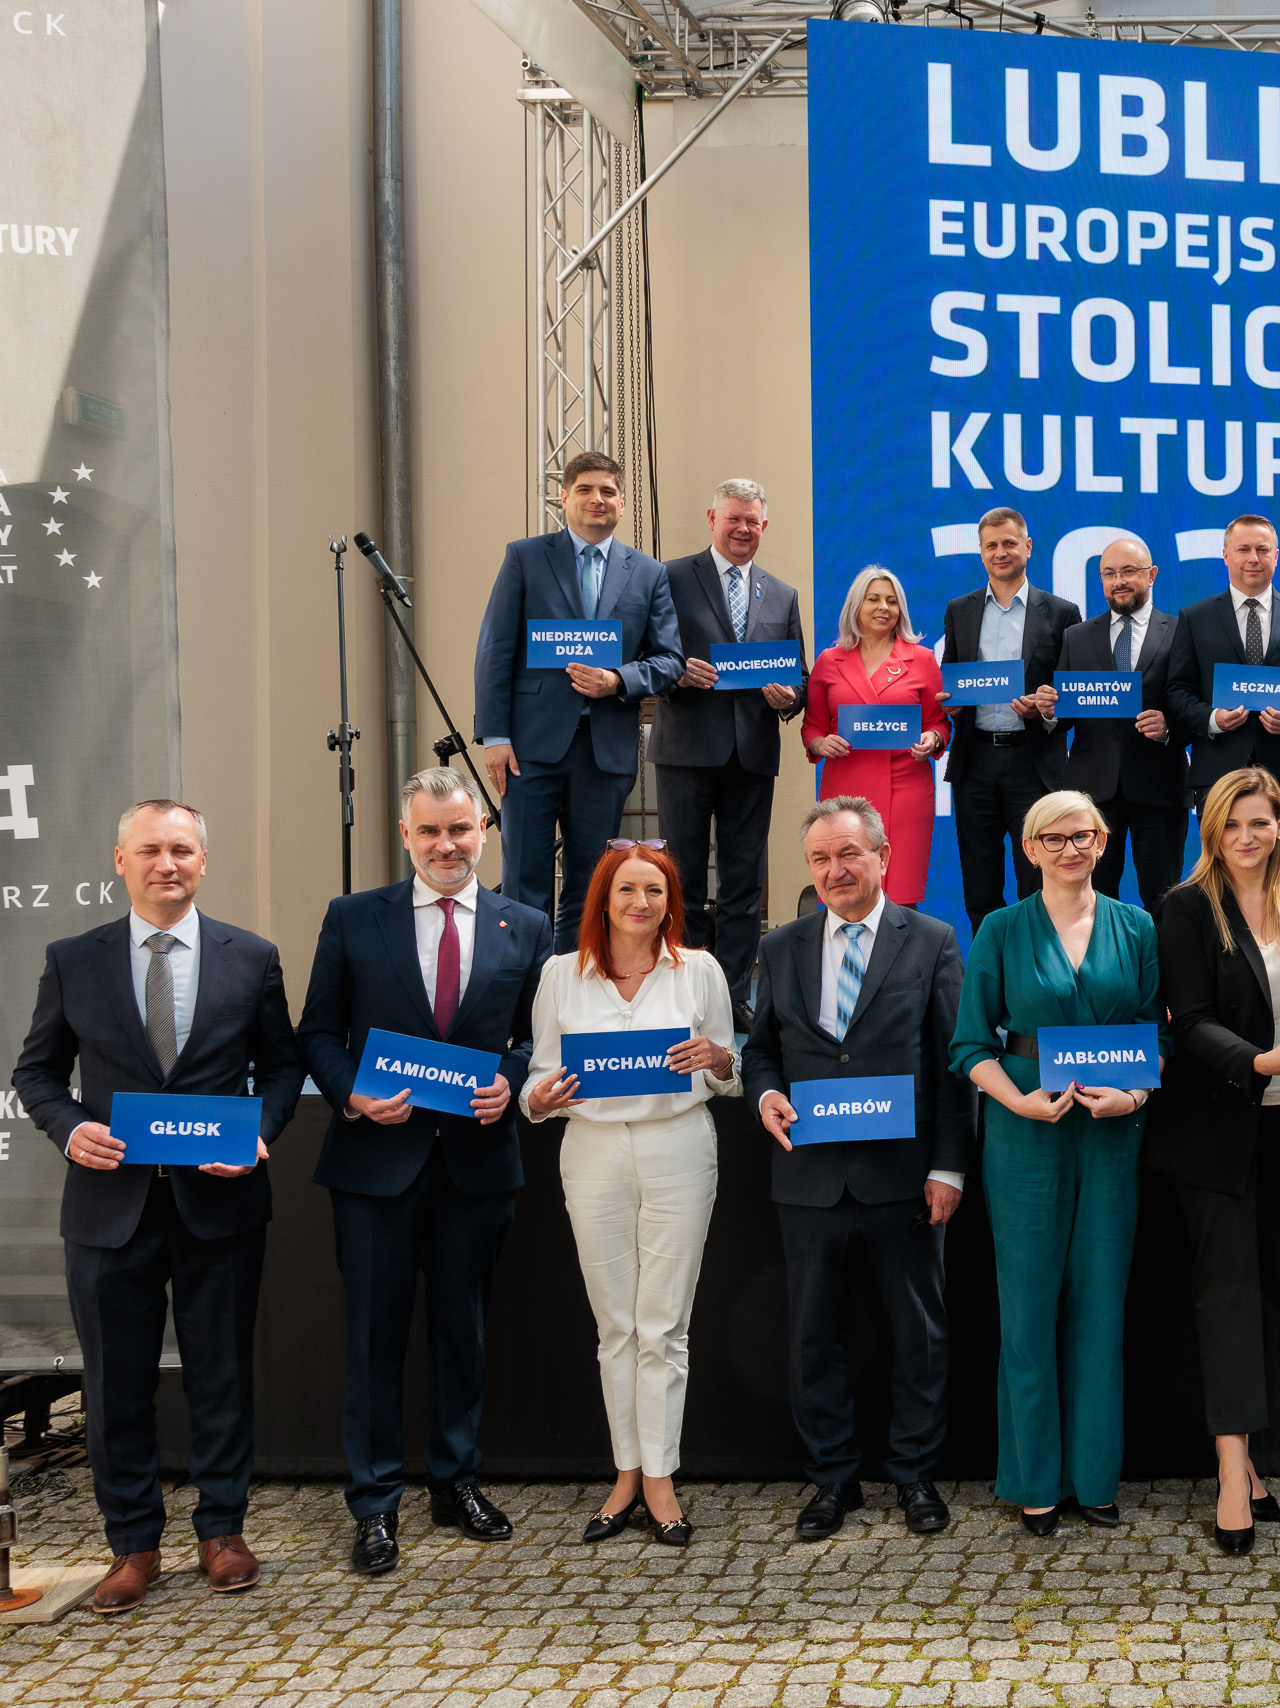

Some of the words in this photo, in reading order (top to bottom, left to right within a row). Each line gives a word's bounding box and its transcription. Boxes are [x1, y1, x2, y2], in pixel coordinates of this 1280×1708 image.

[531, 631, 618, 642] NIEDRZWICA
[555, 644, 594, 656] DUŻA
[715, 657, 797, 671] WOJCIECHÓW
[958, 677, 1008, 688] SPICZYN
[1062, 681, 1131, 691] LUBARTÓW
[1078, 696, 1118, 705] GMINA
[853, 720, 908, 732] BEŁŻYCE
[1054, 1050, 1146, 1064] JABŁONNA
[375, 1056, 478, 1089] KAMIONKA
[813, 1099, 891, 1116] GARBÓW
[150, 1121, 221, 1136] GŁUSK
